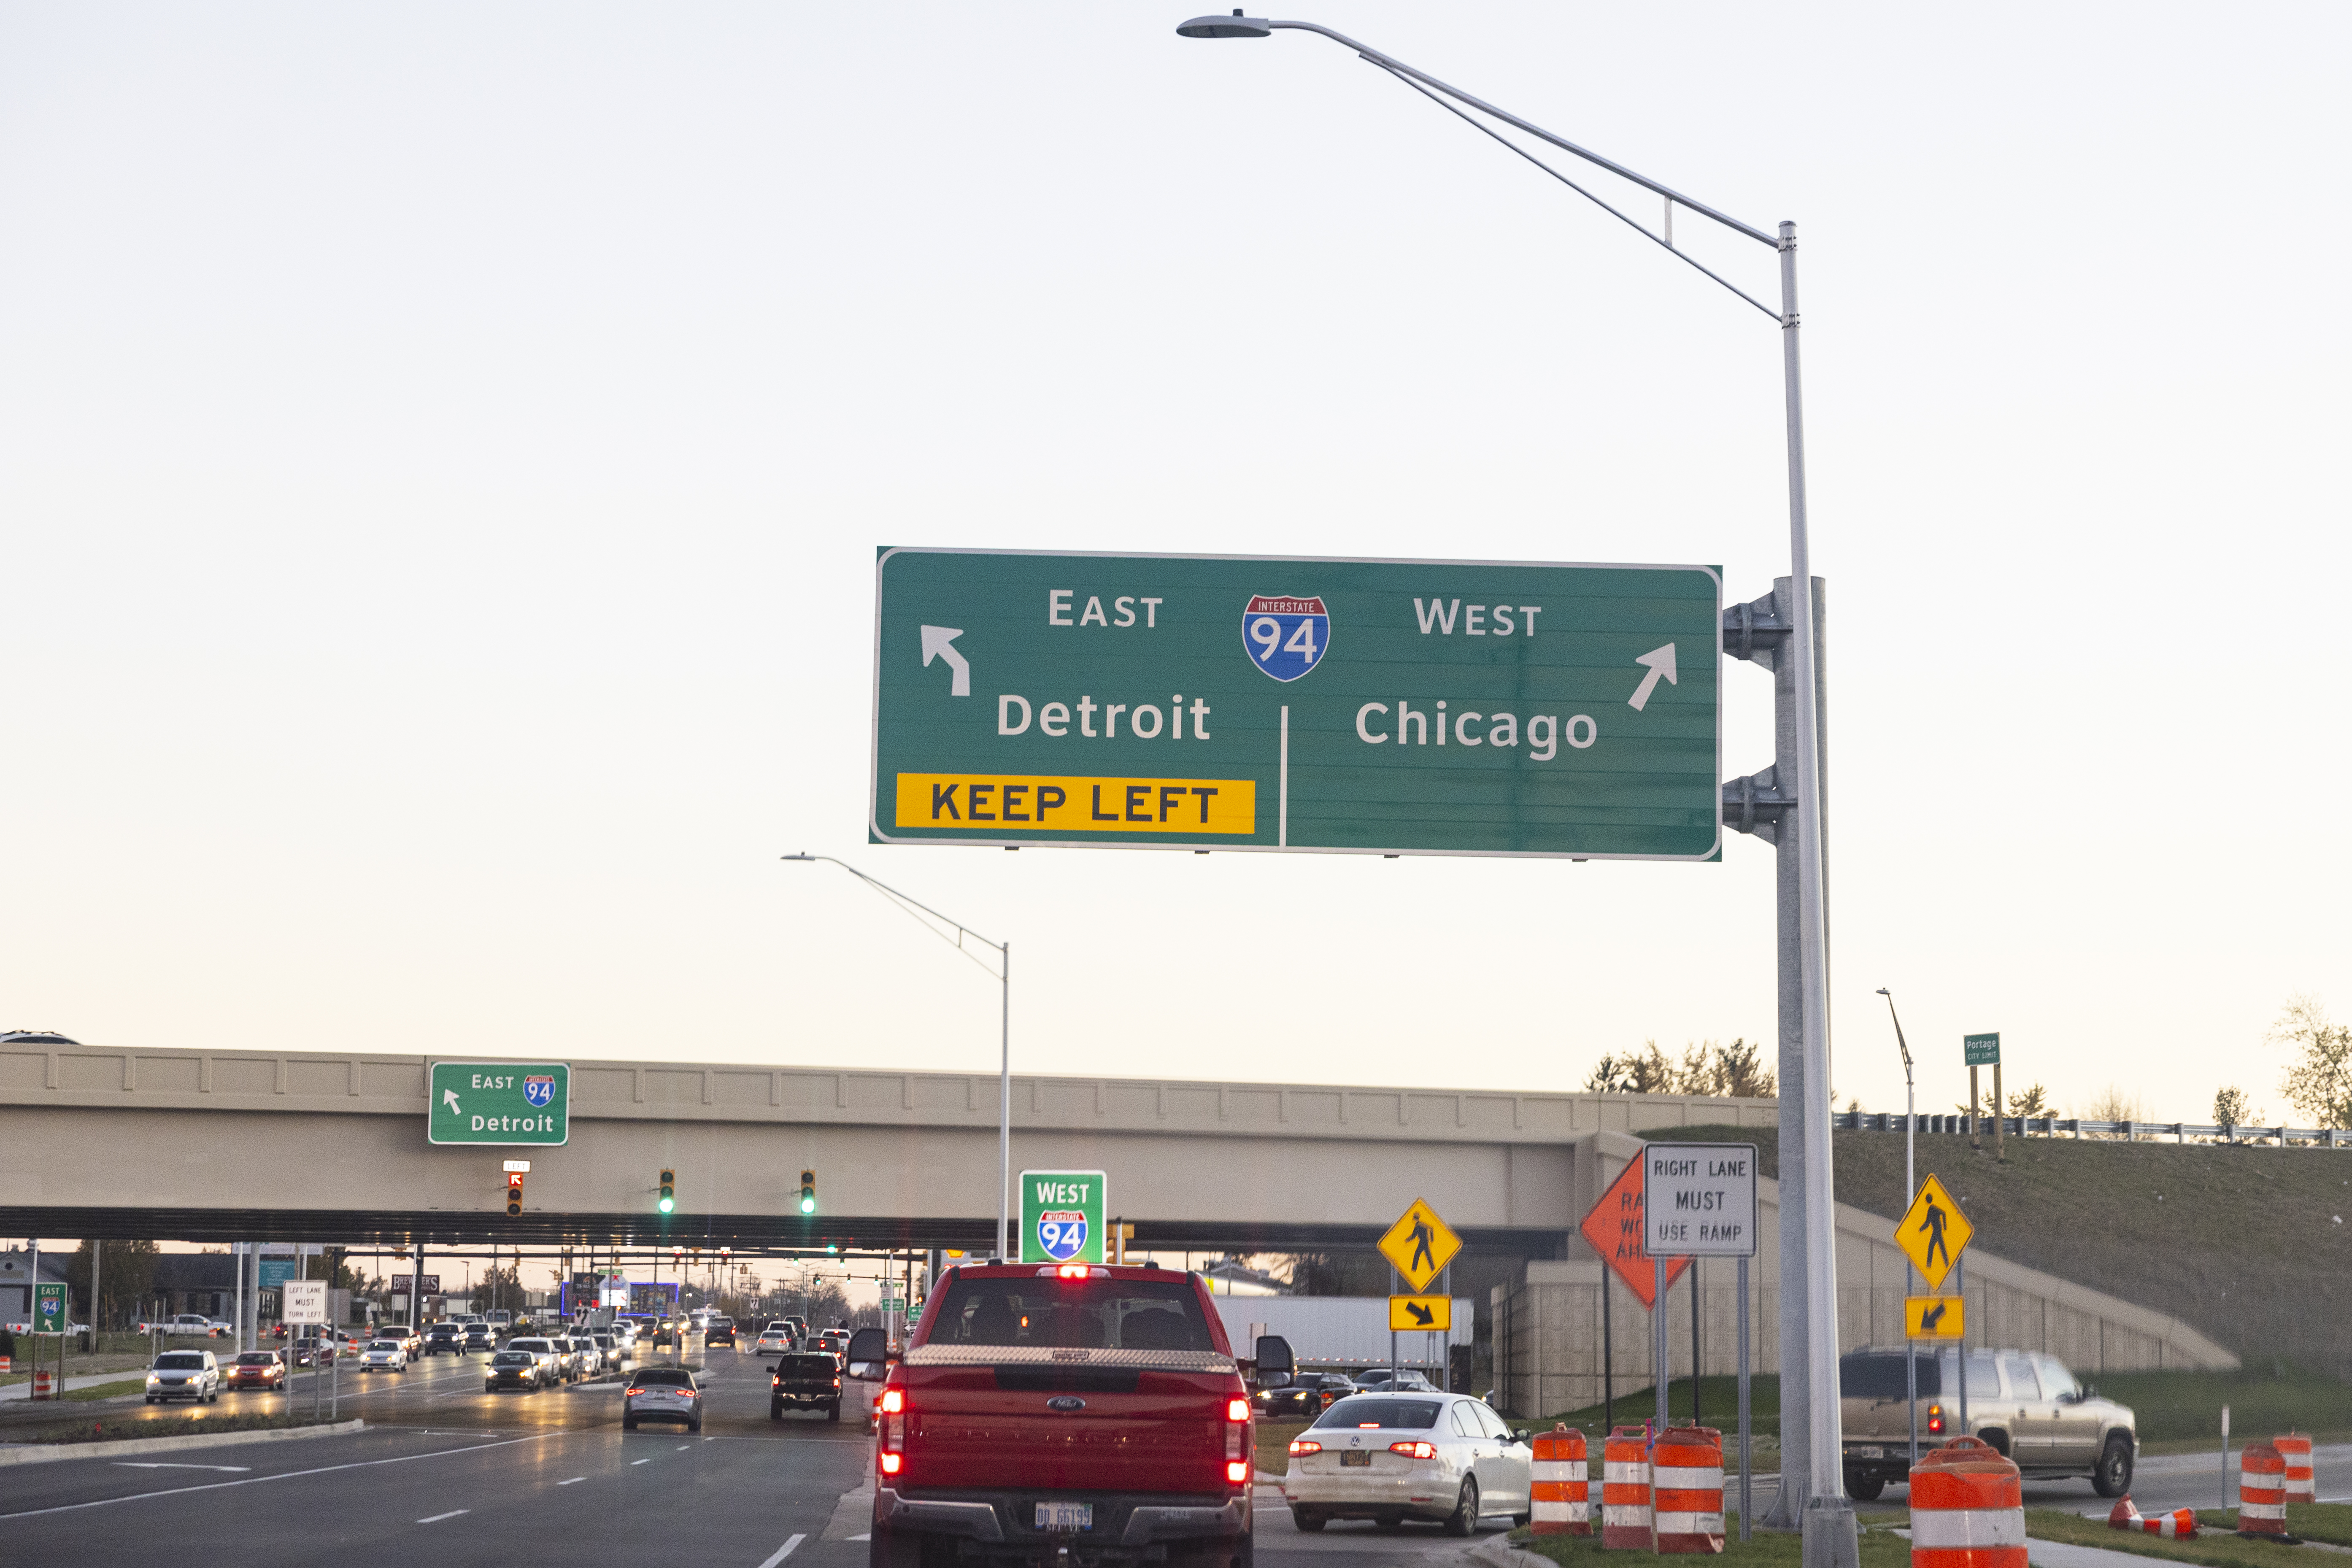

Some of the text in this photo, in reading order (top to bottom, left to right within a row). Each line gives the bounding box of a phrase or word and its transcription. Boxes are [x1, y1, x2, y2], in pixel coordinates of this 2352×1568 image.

[1049, 589, 1163, 628] EAST
[1258, 601, 1315, 613] INTERSTATE
[1413, 597, 1542, 637] WEST
[1250, 617, 1317, 663] 94
[998, 694, 1210, 740] Detroit
[1356, 700, 1598, 761] Chicago
[931, 783, 1219, 824] KEEP LEFT
[1967, 1040, 1996, 1050] Portage
[1982, 1051, 1996, 1059] LIMIT
[472, 1074, 514, 1089] EAST
[528, 1083, 550, 1101] 94
[472, 1114, 553, 1132] Detroit
[1654, 1160, 1747, 1177] RIGHT LANE
[1036, 1182, 1090, 1204] WEST
[1621, 1193, 1643, 1211] RA
[1676, 1191, 1725, 1210] MUST
[1042, 1223, 1081, 1251] 94
[1621, 1219, 1643, 1238] WO
[1659, 1223, 1742, 1241] USE RAMP
[41, 1287, 59, 1295] EAST
[42, 1302, 57, 1312] 94
[295, 1298, 314, 1307] MUST
